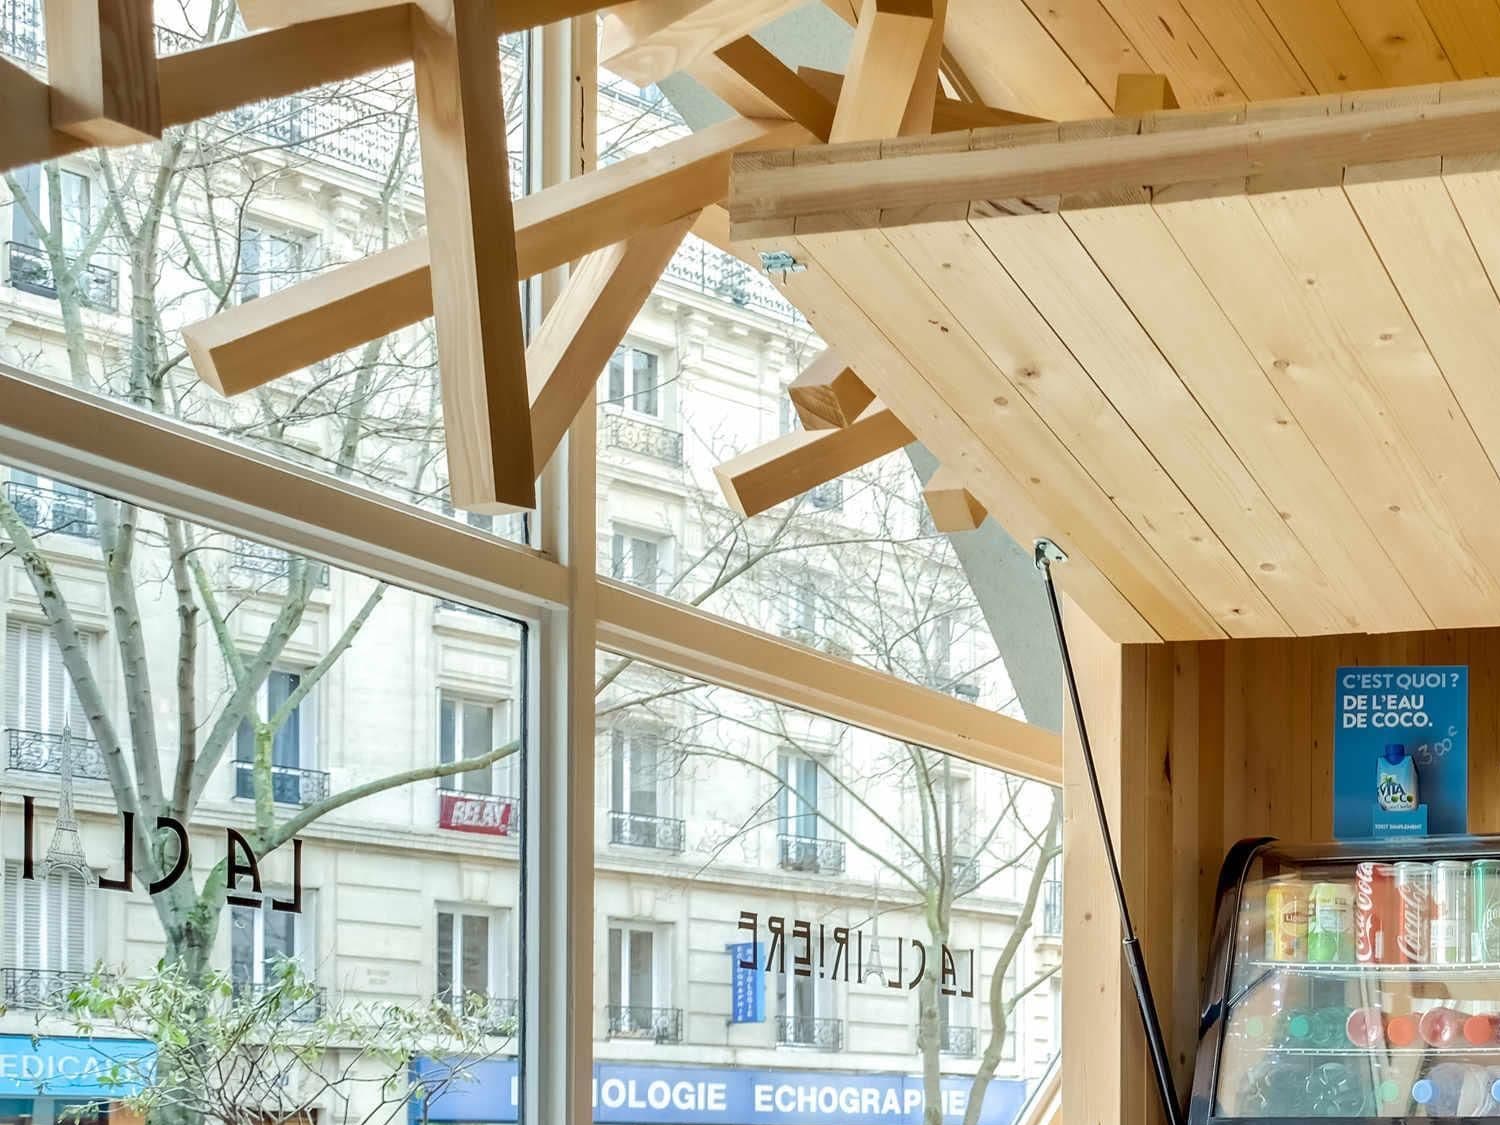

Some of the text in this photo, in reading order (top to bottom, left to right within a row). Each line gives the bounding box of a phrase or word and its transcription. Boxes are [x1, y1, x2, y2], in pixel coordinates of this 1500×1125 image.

[1342, 673, 1394, 689] C'EST
[1396, 673, 1447, 690] QUOI
[1343, 694, 1425, 710] DE L'EAU
[1343, 712, 1433, 728] DE COCO.
[755, 1082, 966, 1116] ECHOGRAPIE
